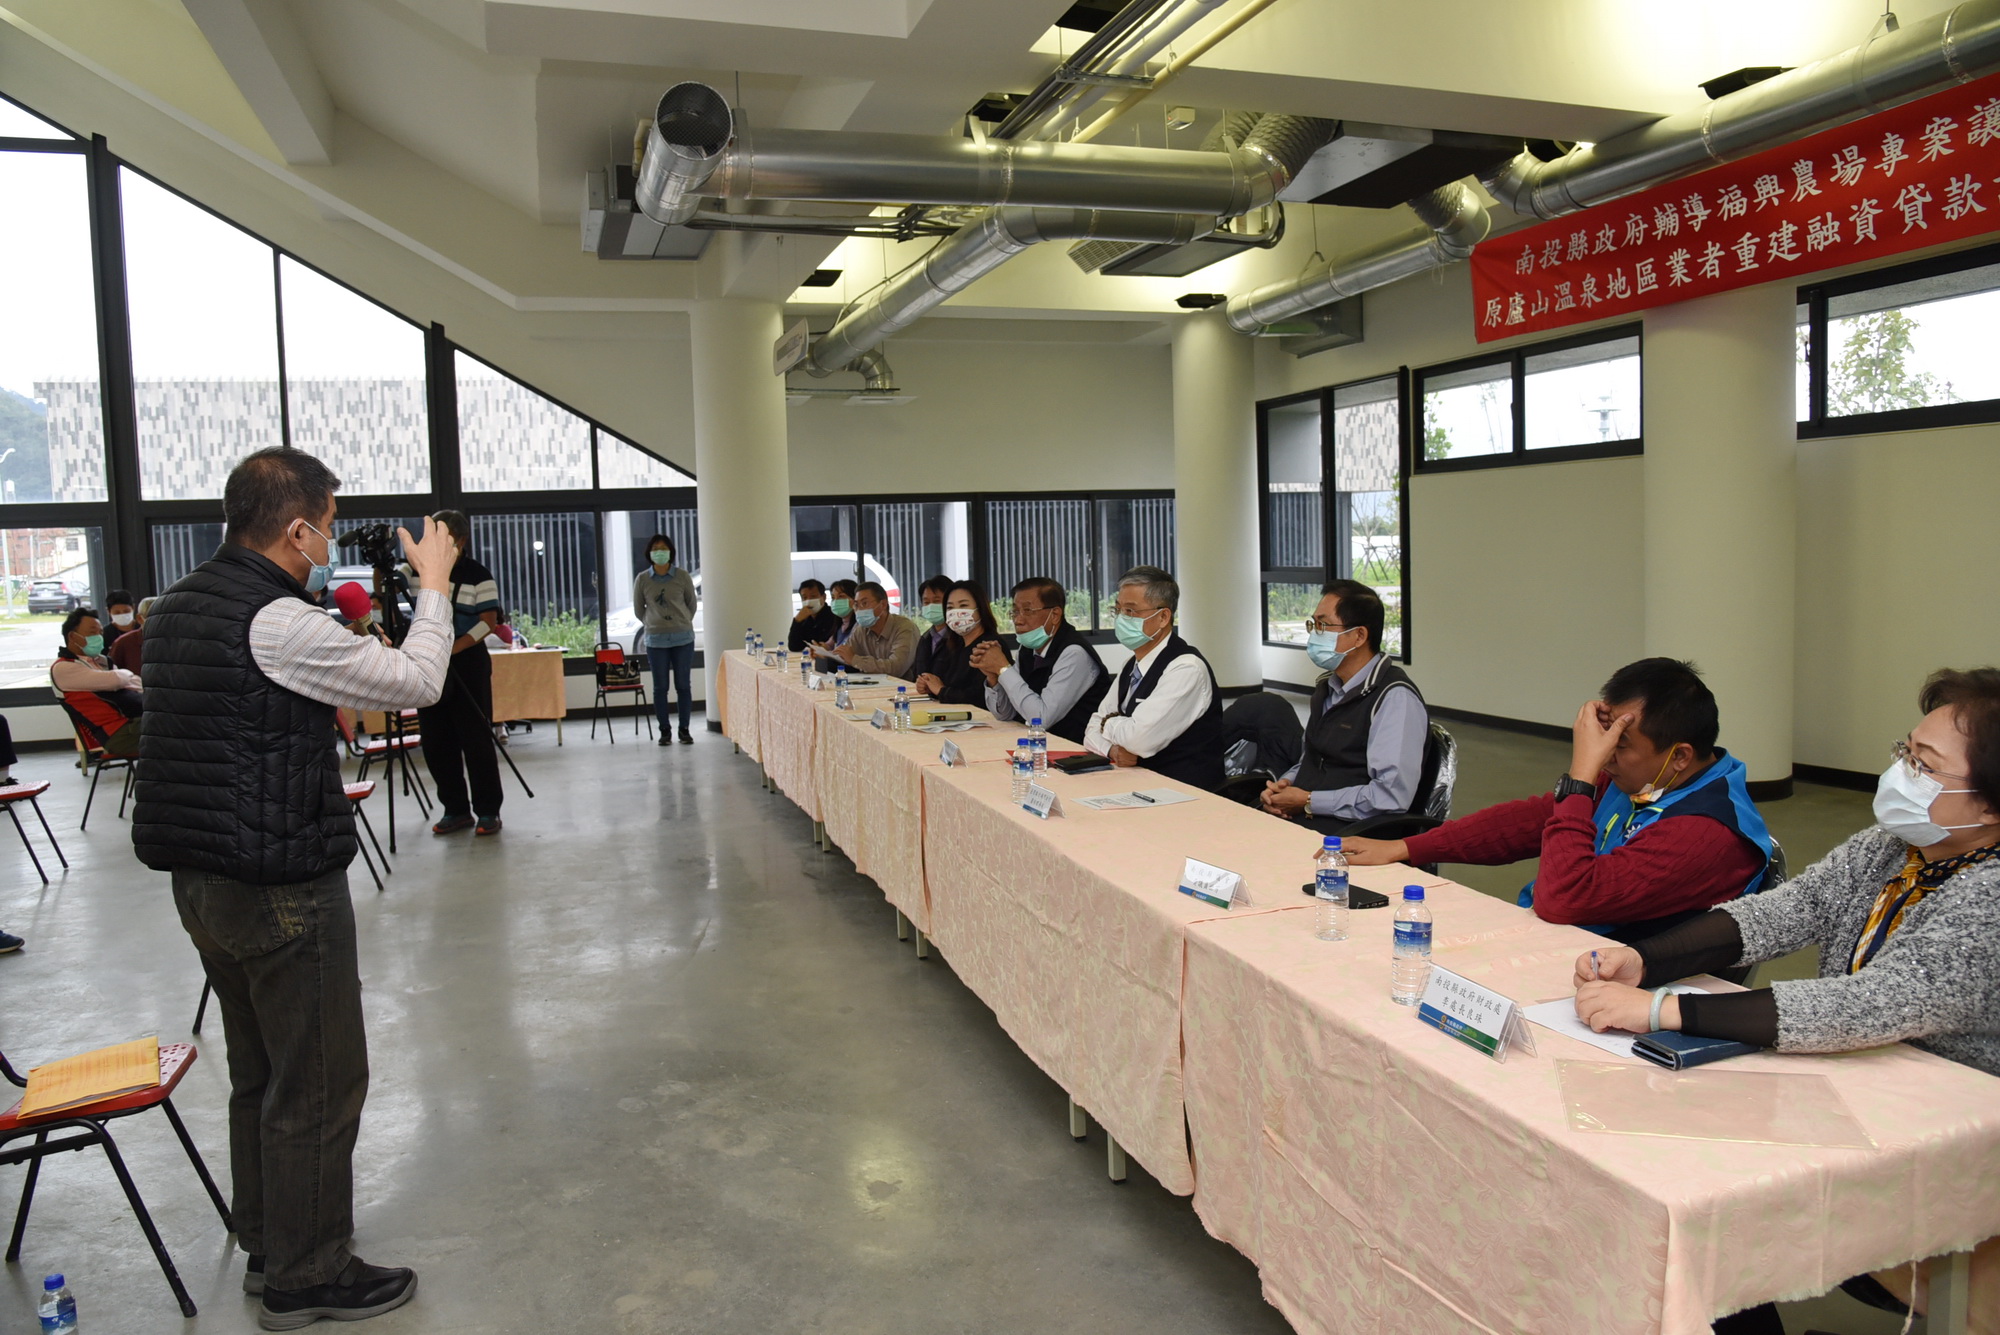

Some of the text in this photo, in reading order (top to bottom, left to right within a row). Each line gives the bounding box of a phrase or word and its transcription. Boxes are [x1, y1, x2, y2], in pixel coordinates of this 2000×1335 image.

[1482, 173, 2000, 328] 原廬山溫泉地區業者重建融資貸款
[1434, 975, 1502, 1016] 南投縣政府財政處
